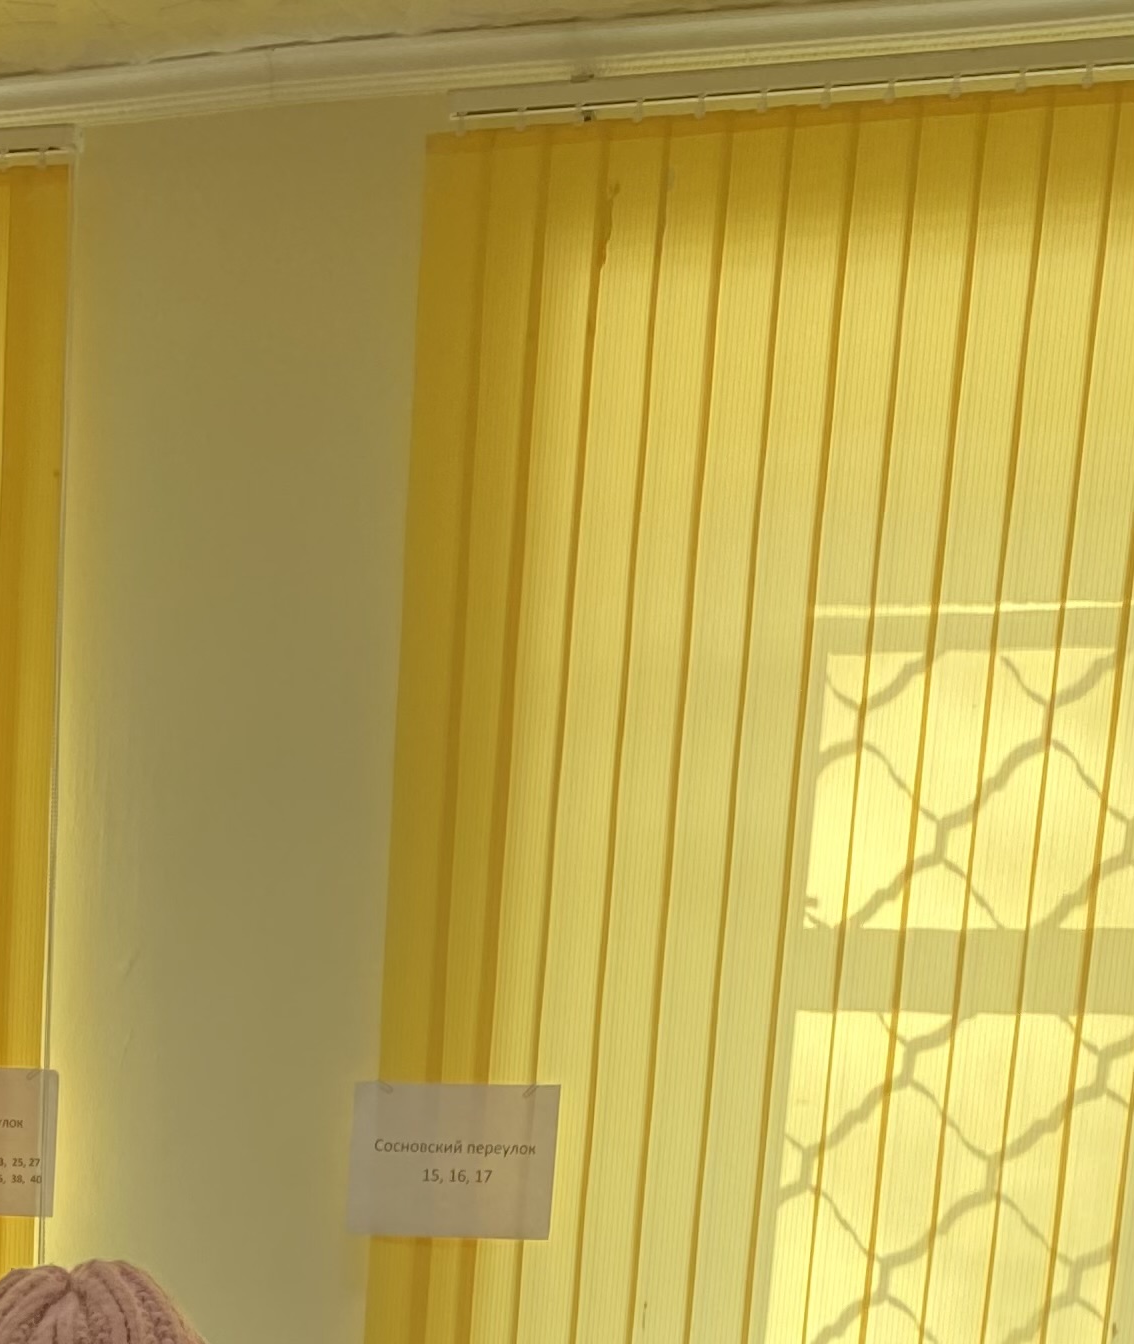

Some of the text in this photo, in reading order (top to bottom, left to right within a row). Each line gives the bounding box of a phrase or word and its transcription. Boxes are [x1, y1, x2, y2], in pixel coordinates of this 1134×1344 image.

[374, 1138, 536, 1158] Сосновский переулок
[12, 1157, 26, 1168] 25,
[29, 1157, 41, 1167] 27
[422, 1168, 493, 1185] 15, 16, 17
